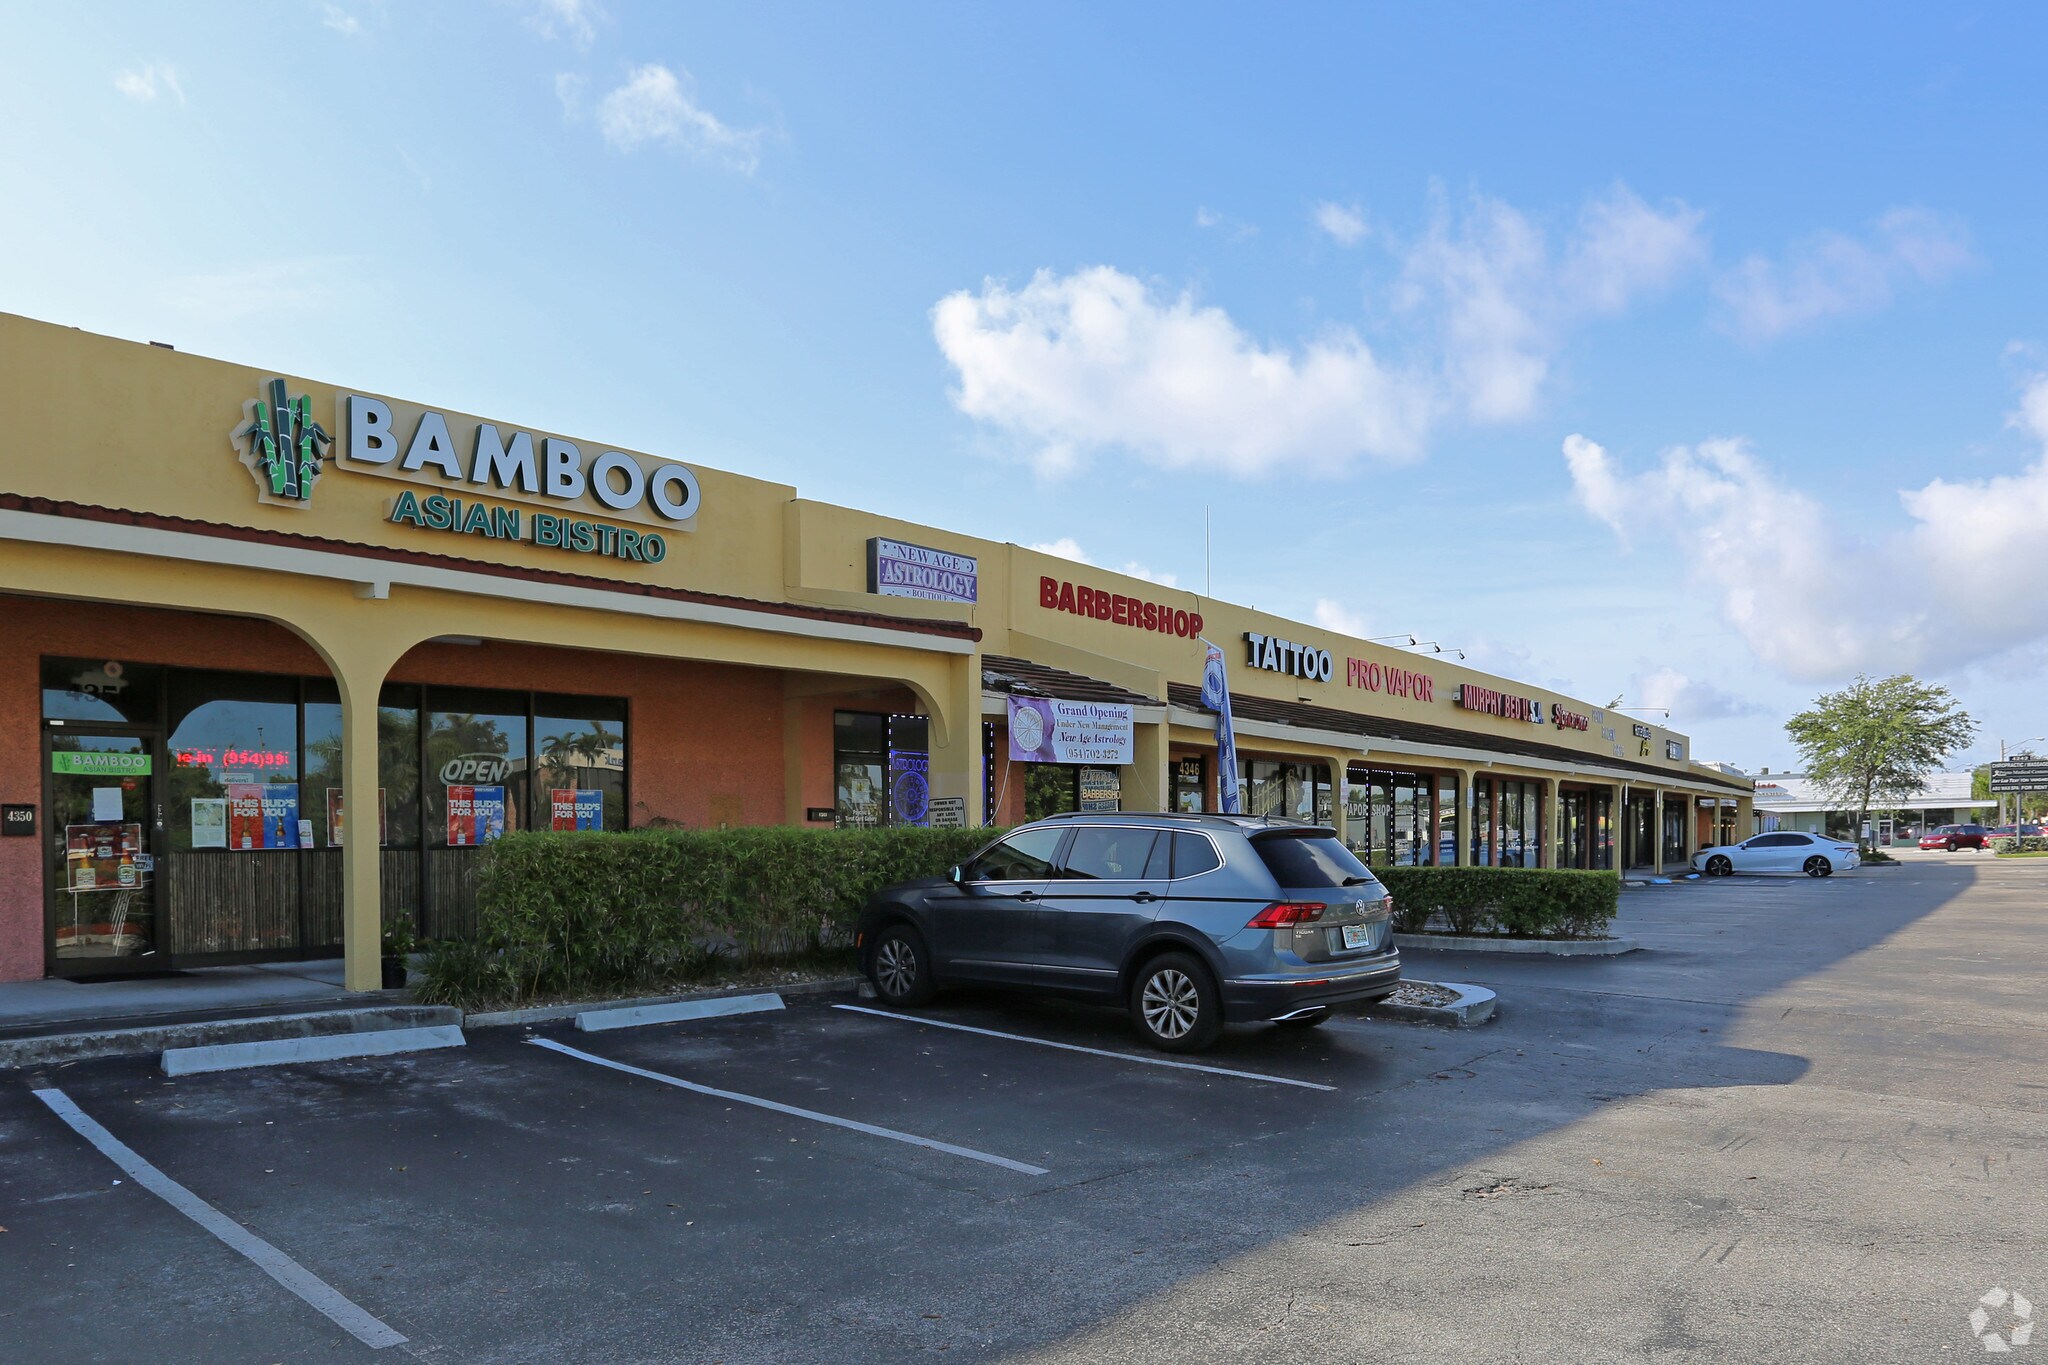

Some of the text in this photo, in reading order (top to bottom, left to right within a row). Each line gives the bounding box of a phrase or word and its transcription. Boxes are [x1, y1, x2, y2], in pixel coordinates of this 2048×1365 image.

[347, 394, 701, 521] BAMBOO
[393, 490, 667, 564] ASIAN BISTRO
[897, 545, 961, 571] NEW AGE
[883, 559, 974, 598] ASTROLOGY
[1040, 576, 1204, 640] BARBERSHOP
[1246, 632, 1333, 684] TATTOO
[1347, 657, 1434, 703] PRO VAPOR
[1464, 684, 1502, 717] MURPHY
[1505, 694, 1521, 720] BED
[1057, 702, 1128, 720] Grand Opening
[1056, 718, 1128, 731] Under New Management
[1059, 732, 1127, 746] New Age Astrology
[1065, 747, 1119, 760] (954)702-3272
[73, 754, 146, 767] BAMBOO
[445, 759, 505, 782] OPEN
[1179, 762, 1200, 775] 4346
[231, 798, 296, 808] THIS BUD'S
[448, 800, 502, 808] THIS BUD'S
[553, 802, 600, 810] THIS BUD'S
[7, 810, 32, 822] 4350
[234, 808, 286, 817] FOR YOU
[450, 808, 494, 816] FOR YOU
[554, 810, 594, 818] FOR YOU
[1370, 804, 1391, 816] SHOP
